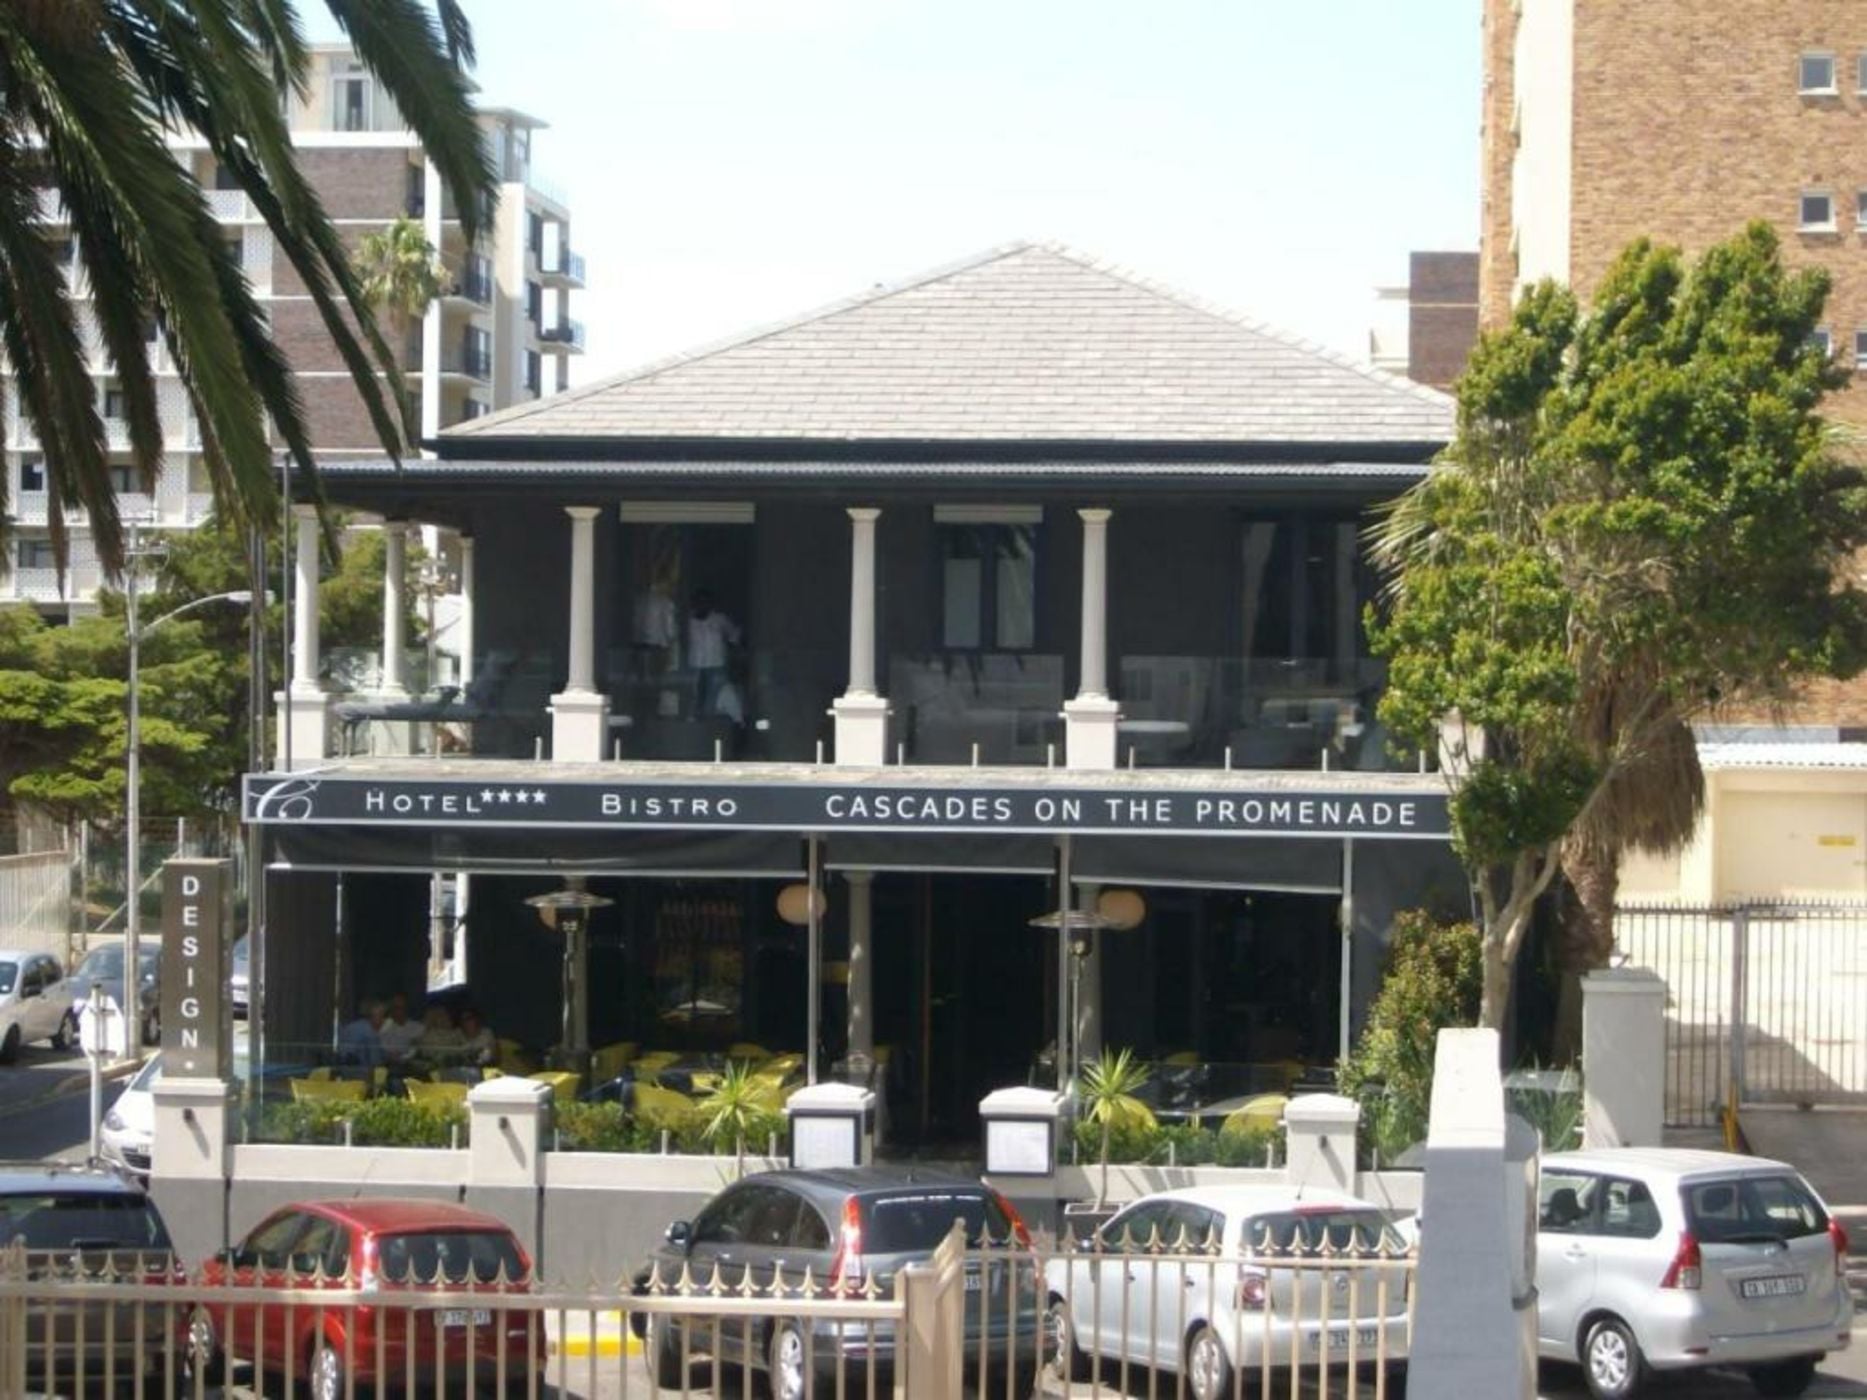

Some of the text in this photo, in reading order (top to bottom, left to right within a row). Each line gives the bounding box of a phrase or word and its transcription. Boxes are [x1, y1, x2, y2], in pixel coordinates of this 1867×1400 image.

[365, 791, 1417, 826] HOTEL BISTRO CASCADES ON THE PROMENADE
[181, 875, 200, 1049] DESIGN
